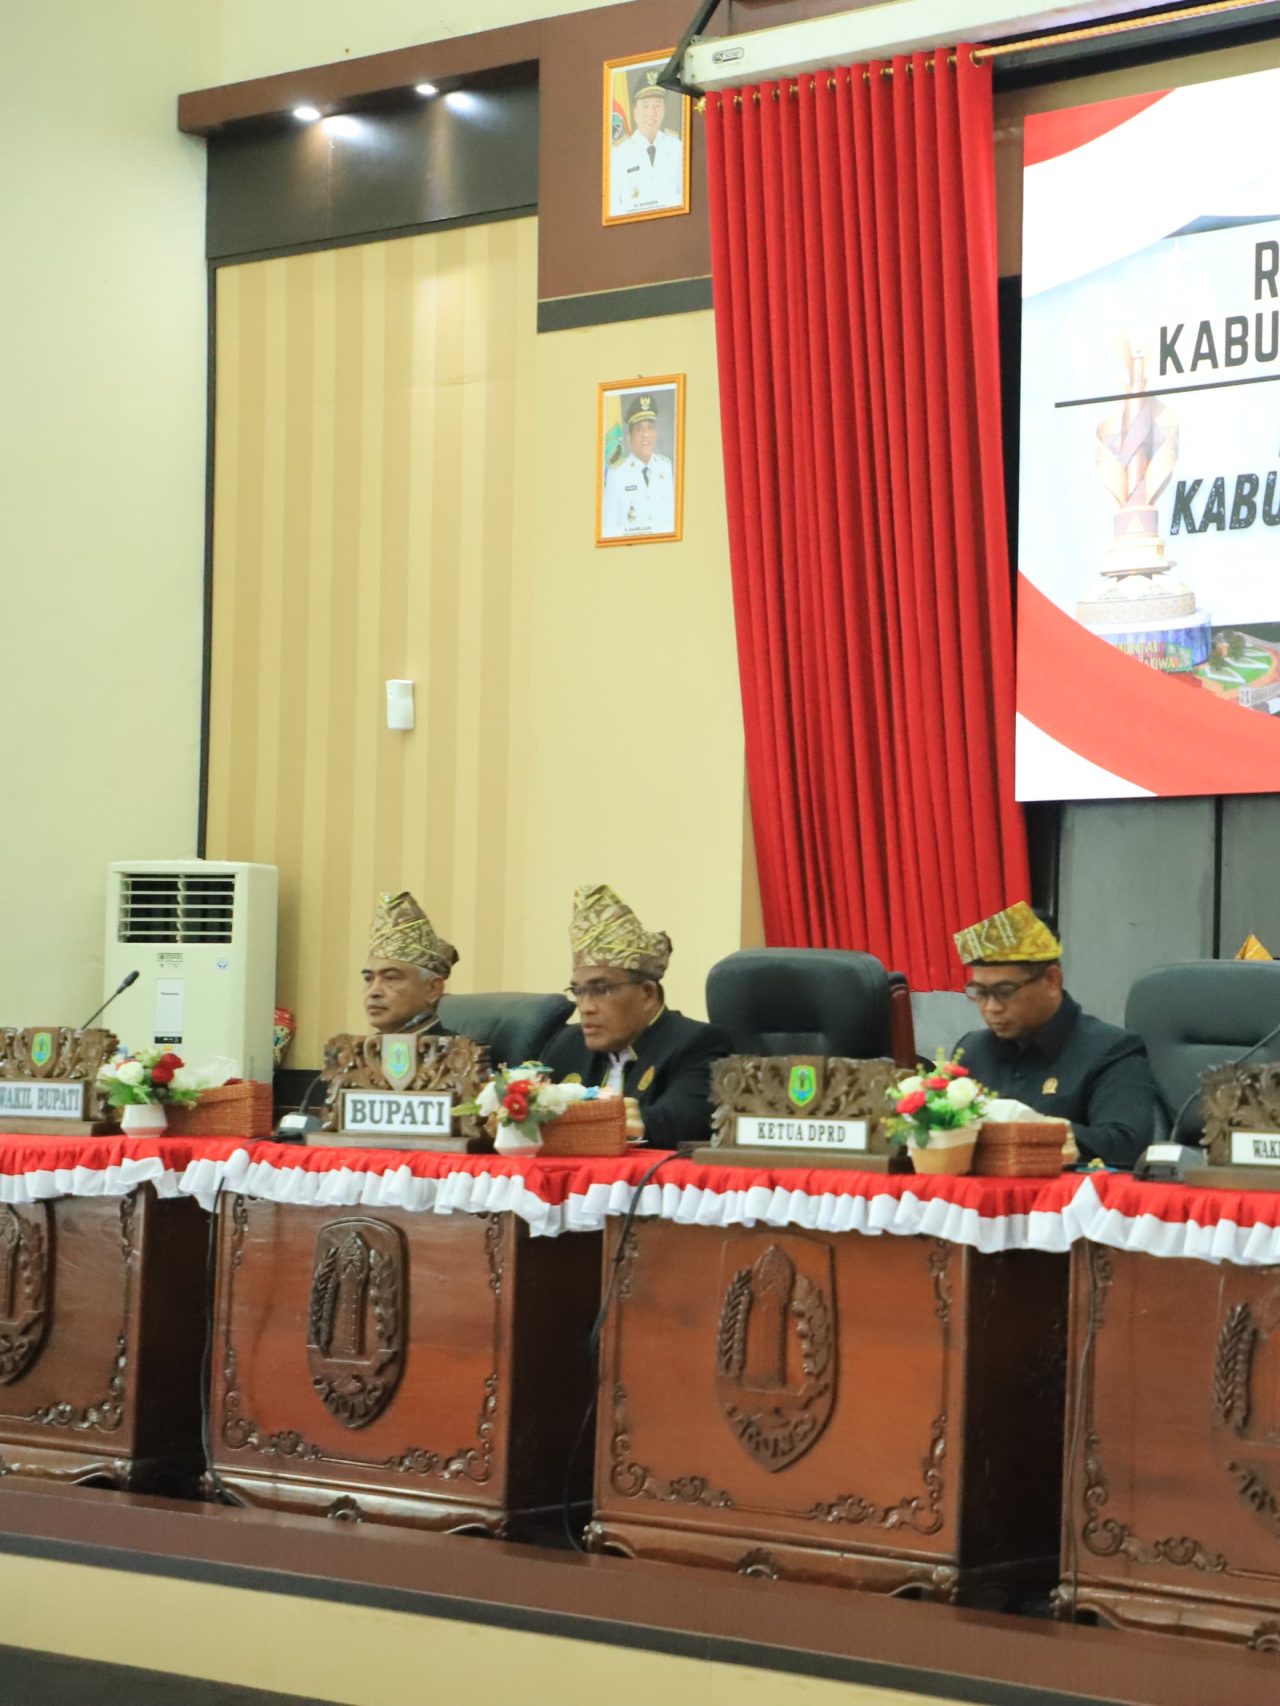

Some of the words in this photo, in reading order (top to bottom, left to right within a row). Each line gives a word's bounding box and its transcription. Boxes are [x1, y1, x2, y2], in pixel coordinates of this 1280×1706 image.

[37, 1087, 80, 1111] BUPATI
[350, 1100, 445, 1127] BUPATI
[757, 1122, 804, 1141] KETUA
[807, 1123, 846, 1142] DPRD
